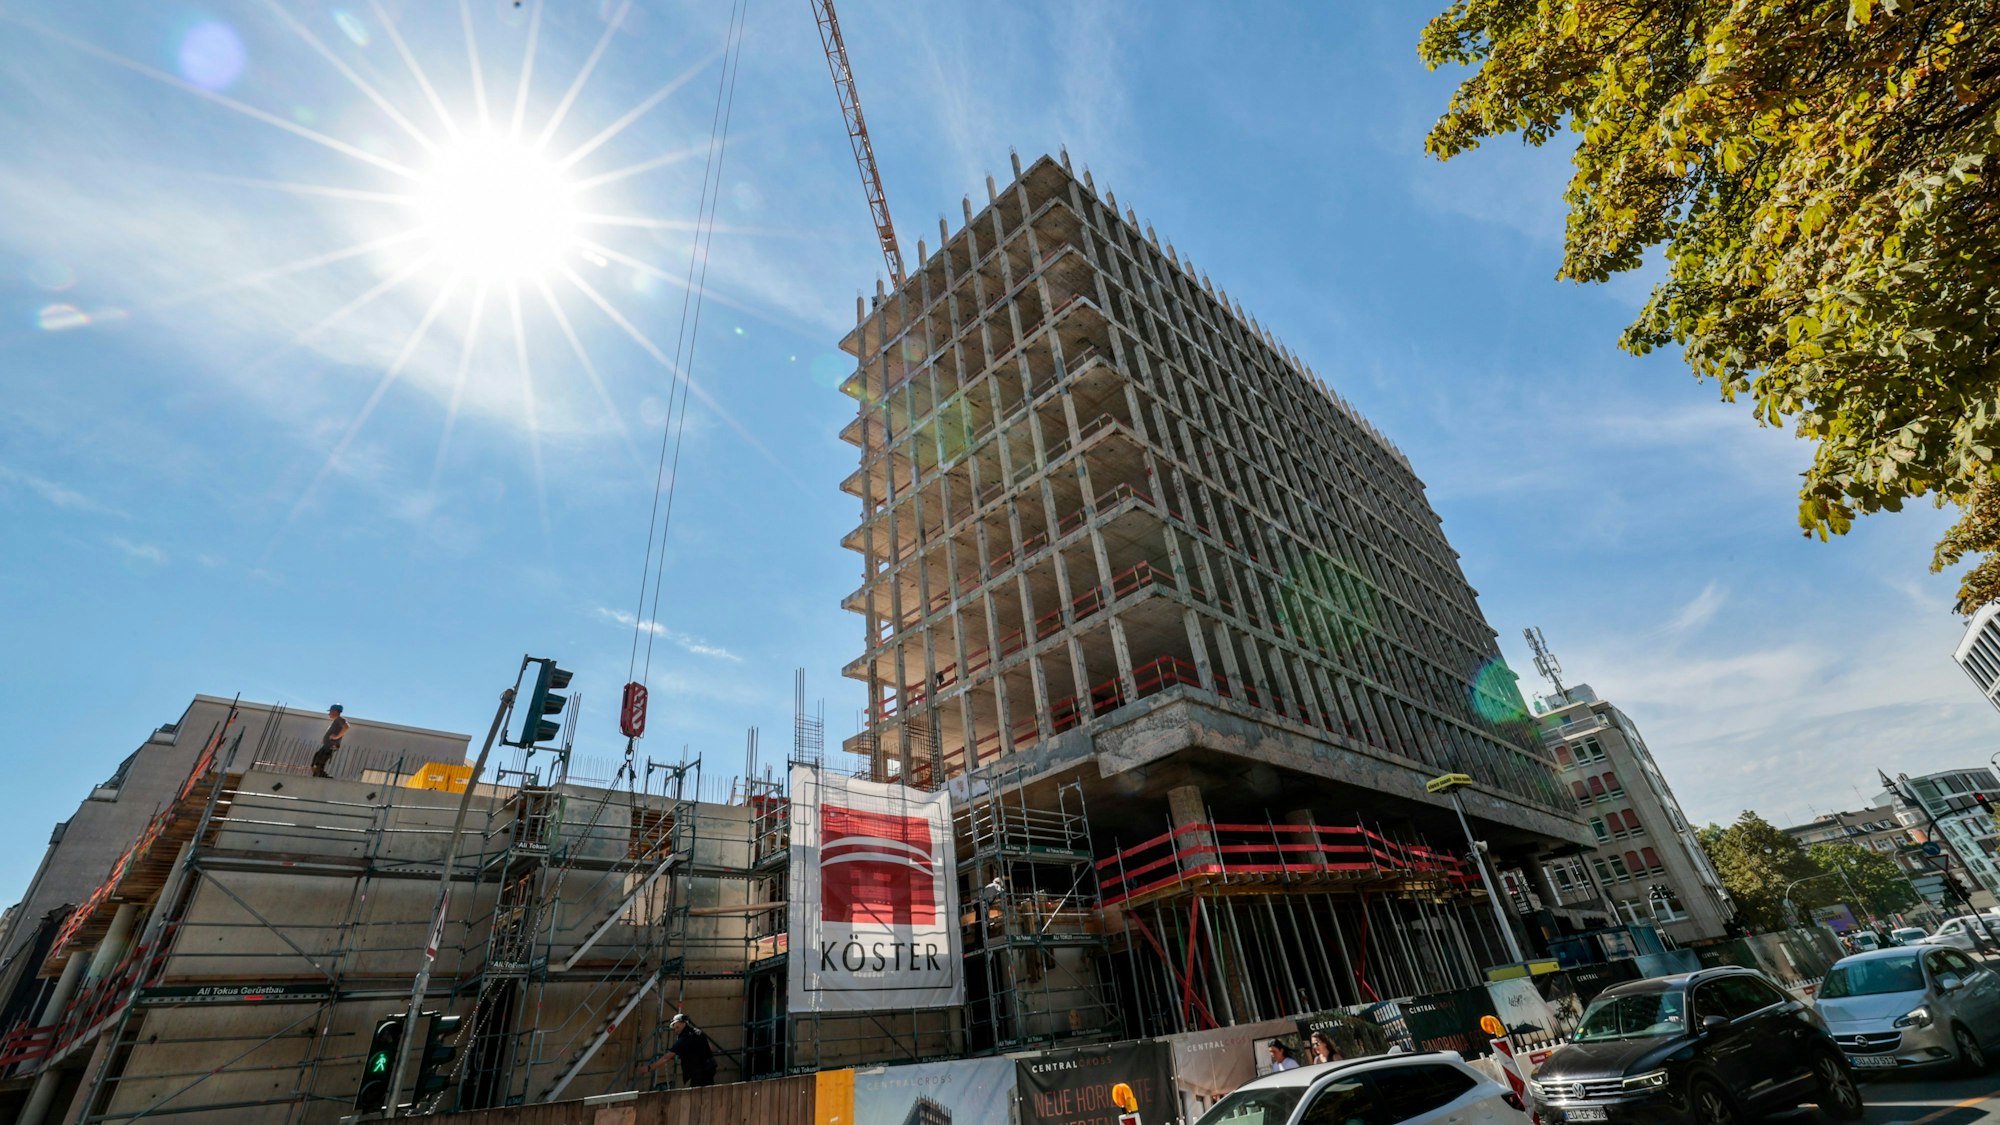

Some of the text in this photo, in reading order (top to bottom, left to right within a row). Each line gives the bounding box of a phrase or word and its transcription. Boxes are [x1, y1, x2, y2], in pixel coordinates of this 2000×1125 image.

[529, 842, 547, 850] Tokus
[821, 934, 941, 972] KÖSTER
[1576, 973, 1598, 982] CENTRAL
[197, 986, 284, 996] Ali Tokus Gerüstbau
[1034, 1078, 1153, 1118] NEUE HORITE
